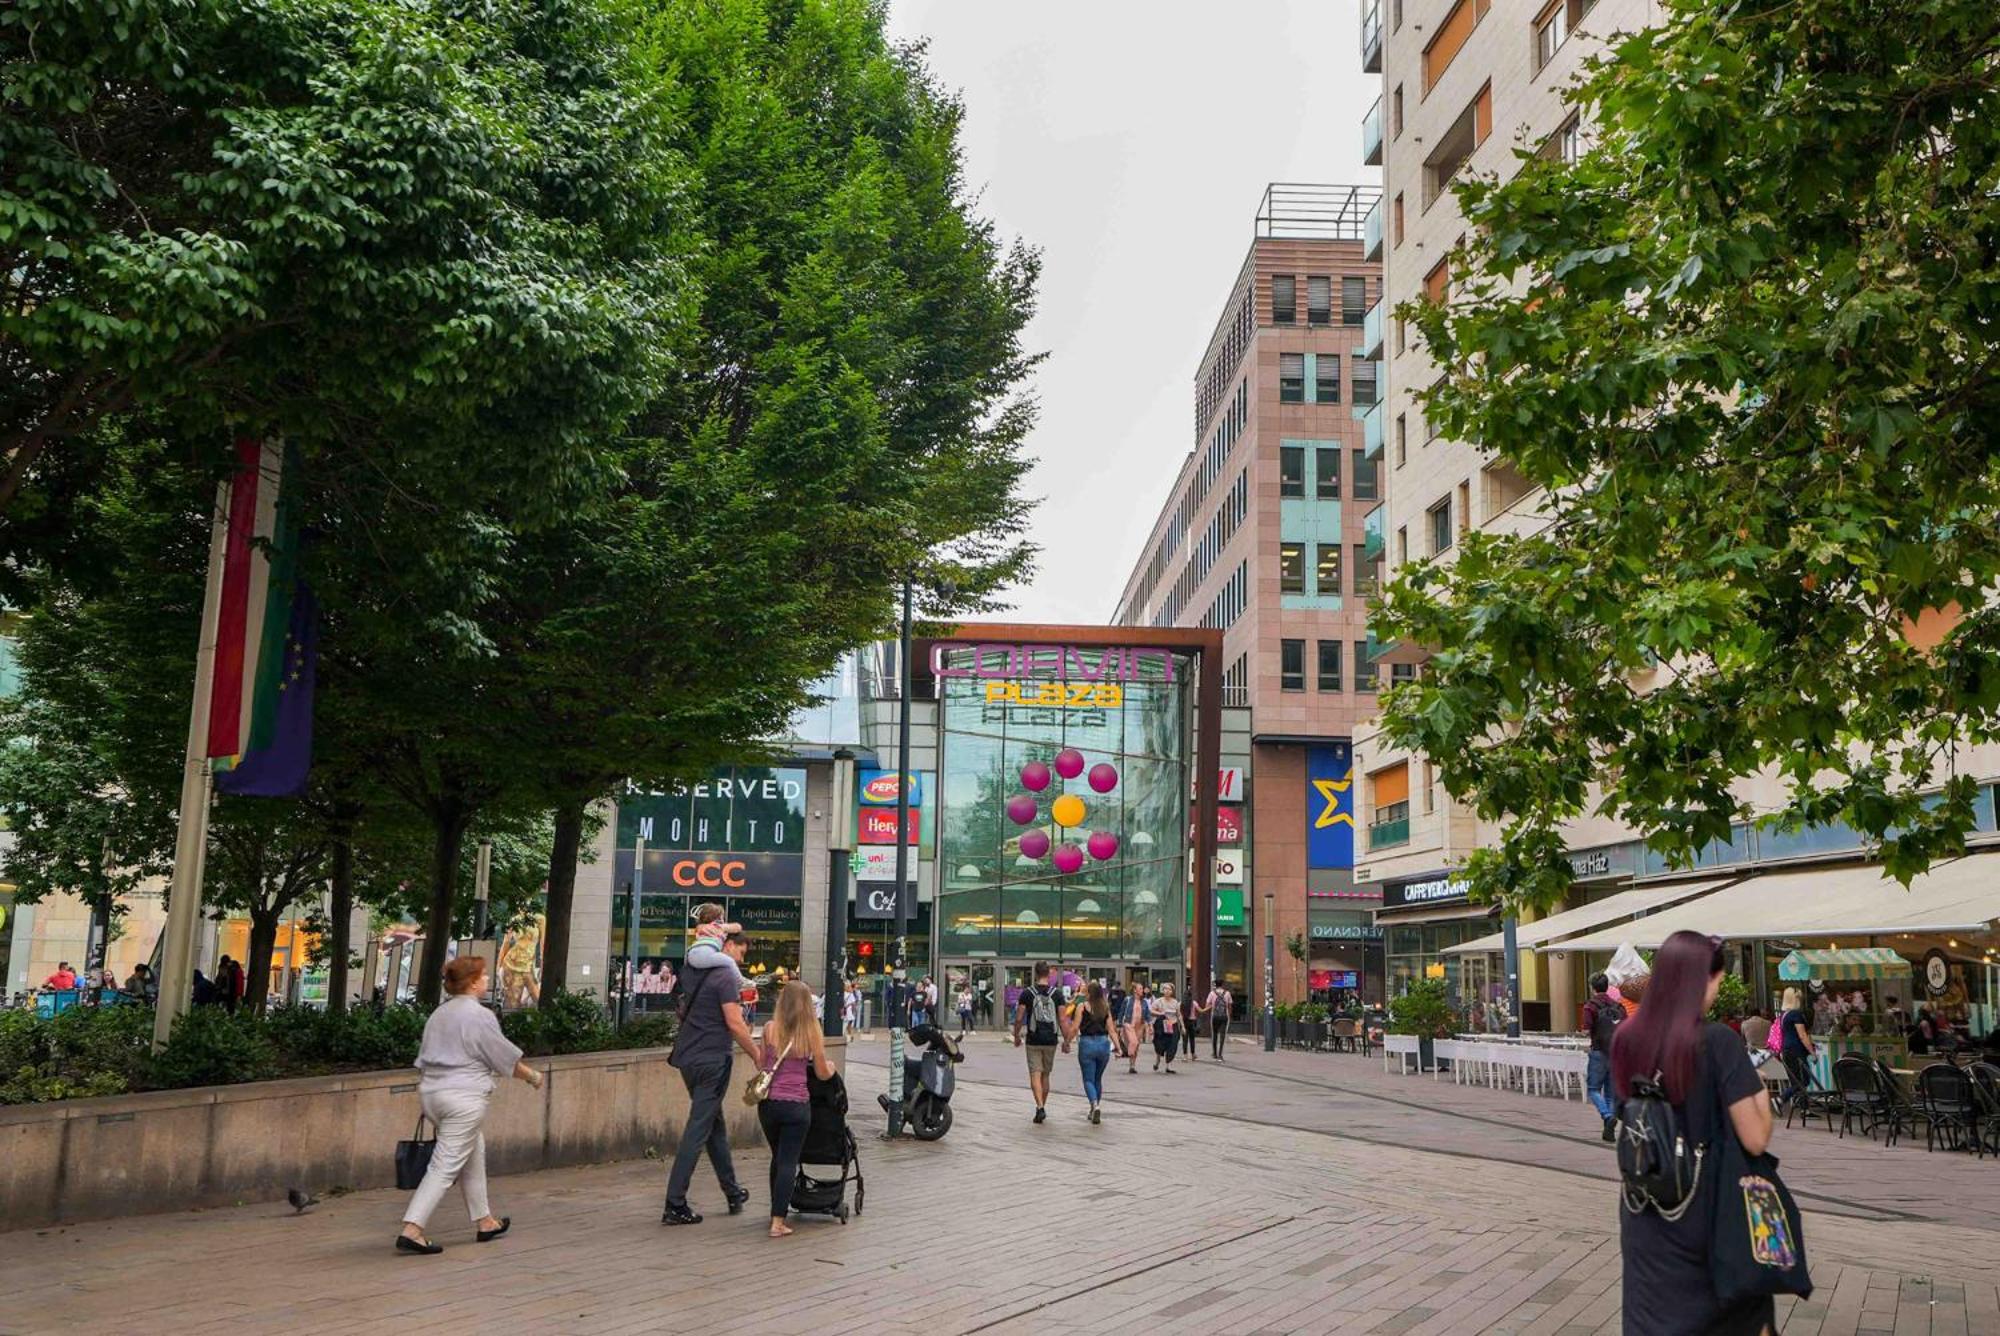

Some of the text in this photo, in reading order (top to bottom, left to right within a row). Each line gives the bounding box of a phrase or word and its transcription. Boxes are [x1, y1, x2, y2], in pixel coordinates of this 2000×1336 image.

[930, 642, 1173, 681] CORVIN
[871, 782, 912, 792] PEPC
[640, 816, 784, 844] MOHITO
[868, 817, 911, 835] Herv
[672, 860, 747, 887] CCC
